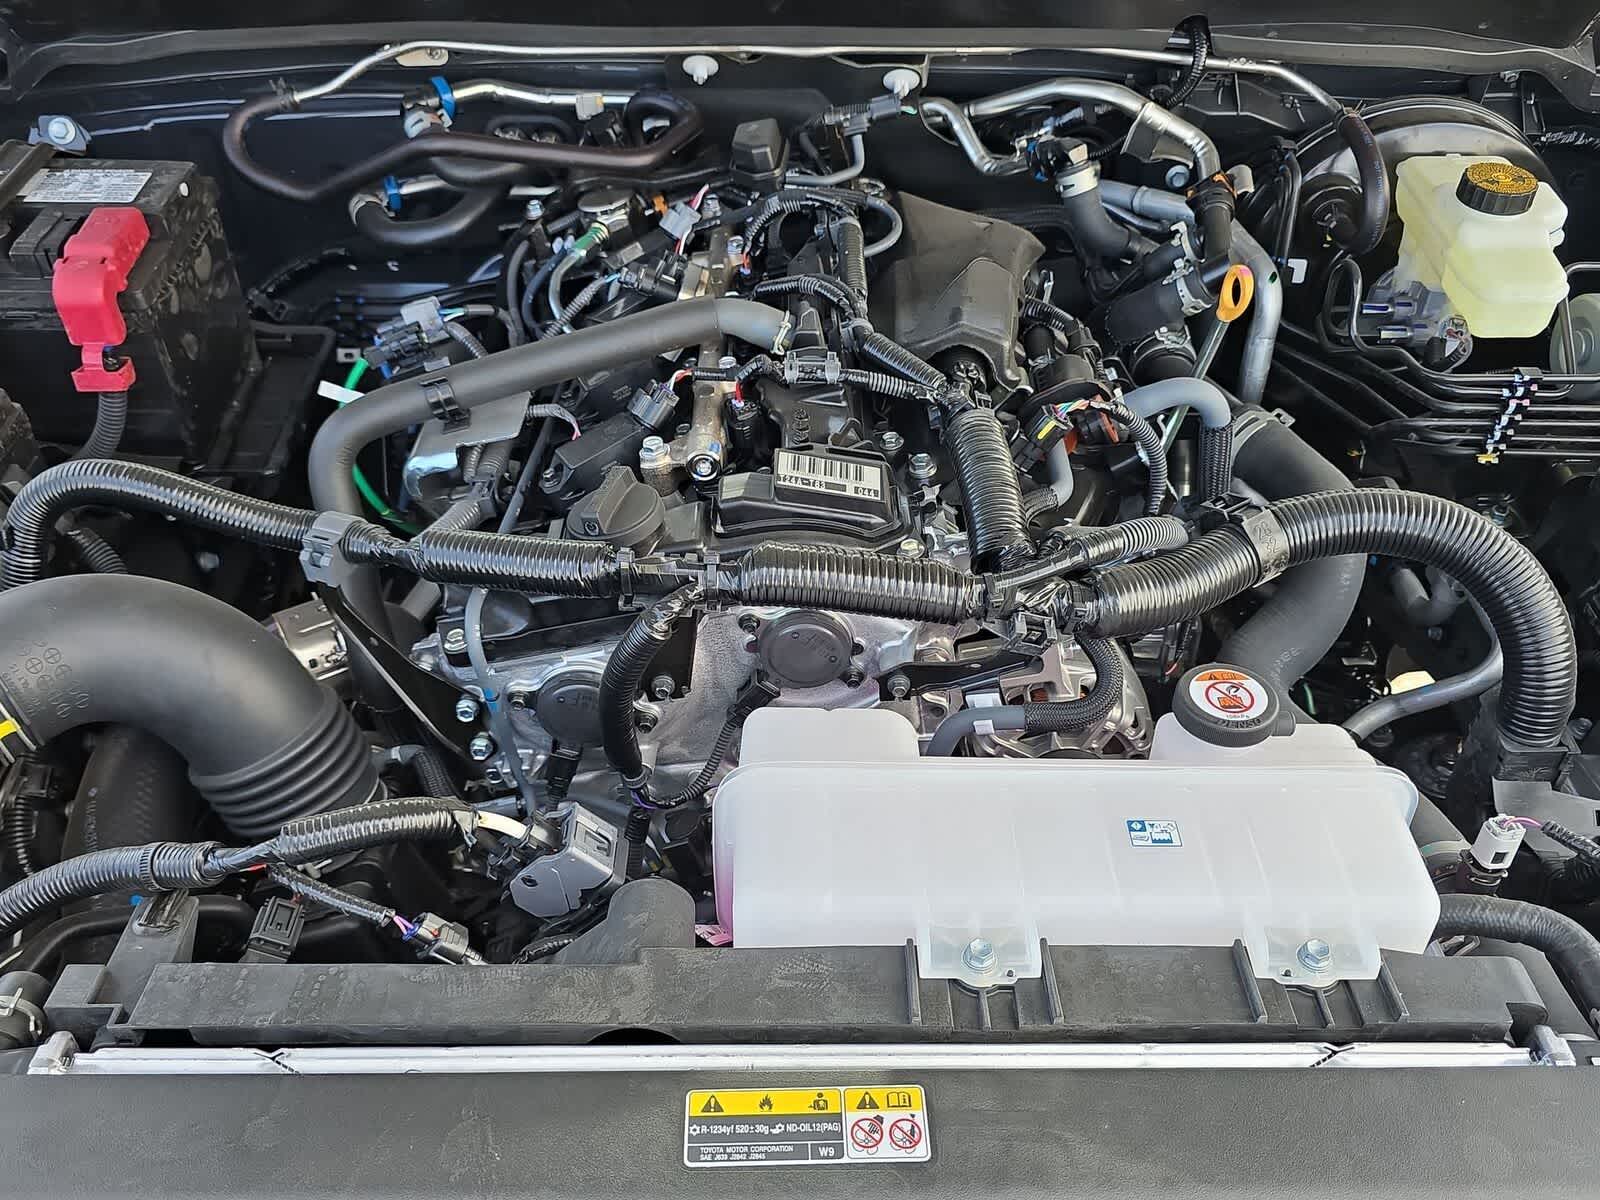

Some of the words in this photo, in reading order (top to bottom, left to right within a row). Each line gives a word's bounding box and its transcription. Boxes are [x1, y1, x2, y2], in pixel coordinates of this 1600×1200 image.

[1218, 718, 1263, 728] DENSO
[701, 1125, 734, 1135] R-1234yf
[735, 1124, 770, 1134] 520±30g
[786, 1122, 841, 1133] ND-OIL12(PAG)
[750, 1145, 794, 1153] CORPORATION
[818, 1147, 835, 1157] W9
